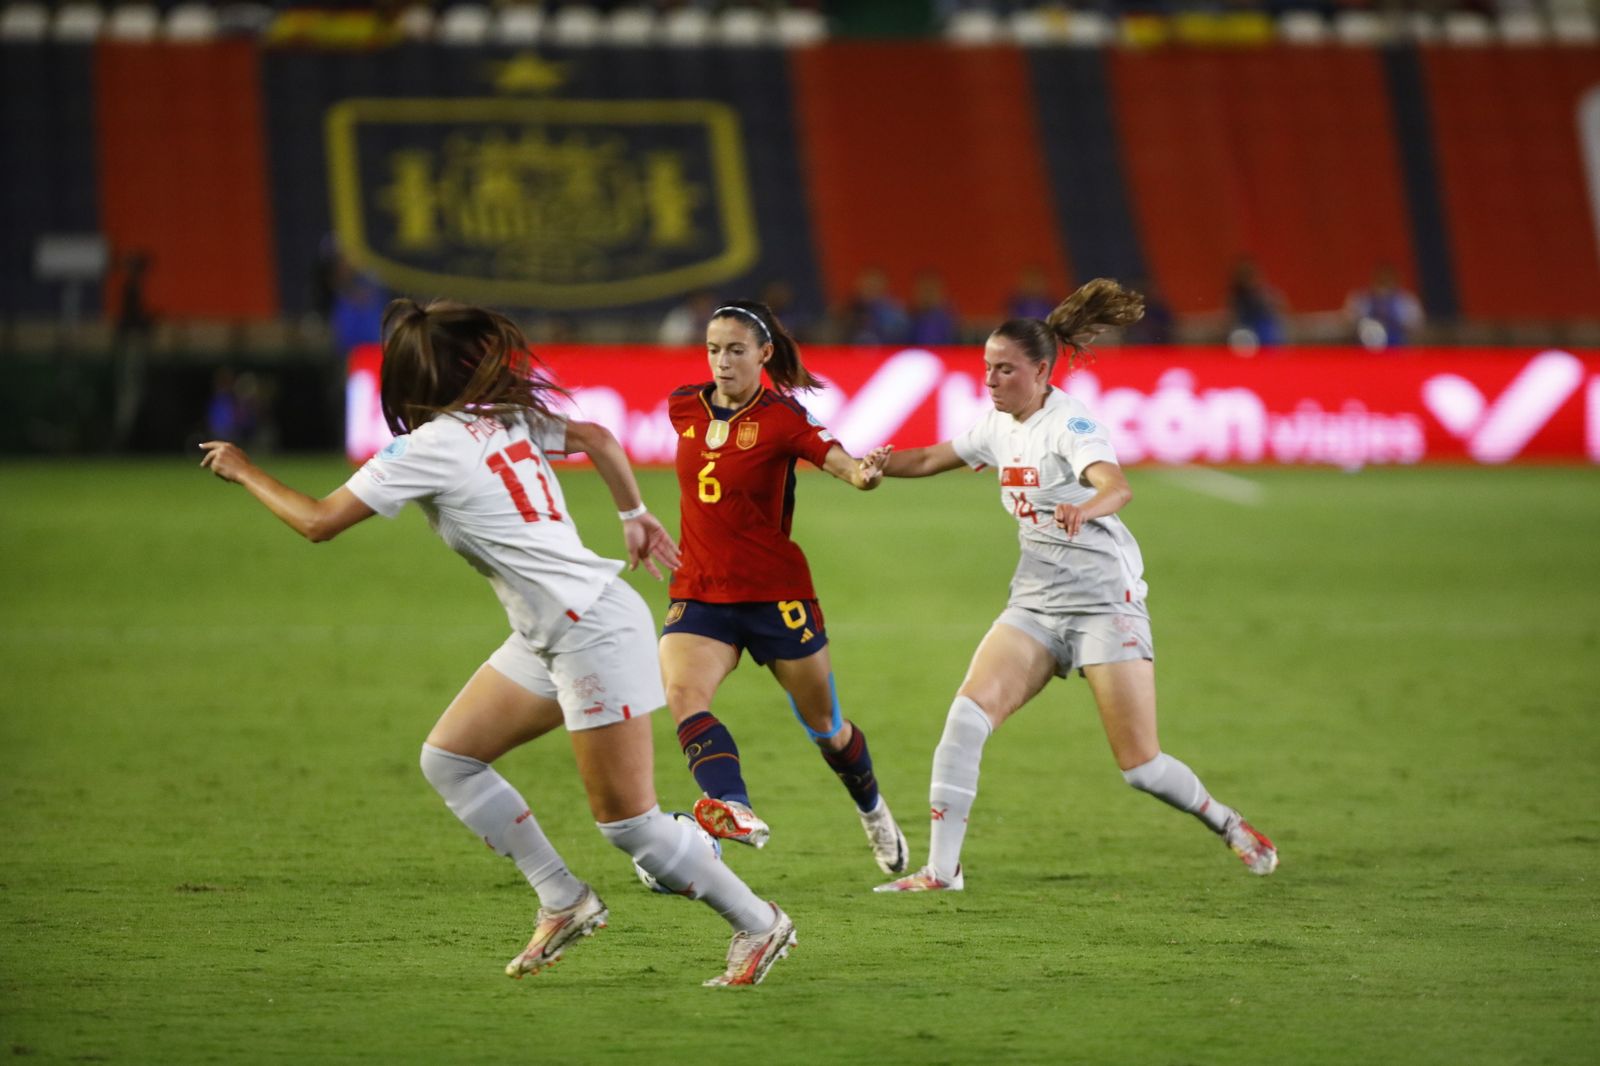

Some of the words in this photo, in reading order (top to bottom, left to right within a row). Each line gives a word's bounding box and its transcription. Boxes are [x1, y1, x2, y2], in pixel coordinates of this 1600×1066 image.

[485, 438, 562, 523] 17
[698, 461, 722, 504] 6
[1009, 491, 1039, 525] 14
